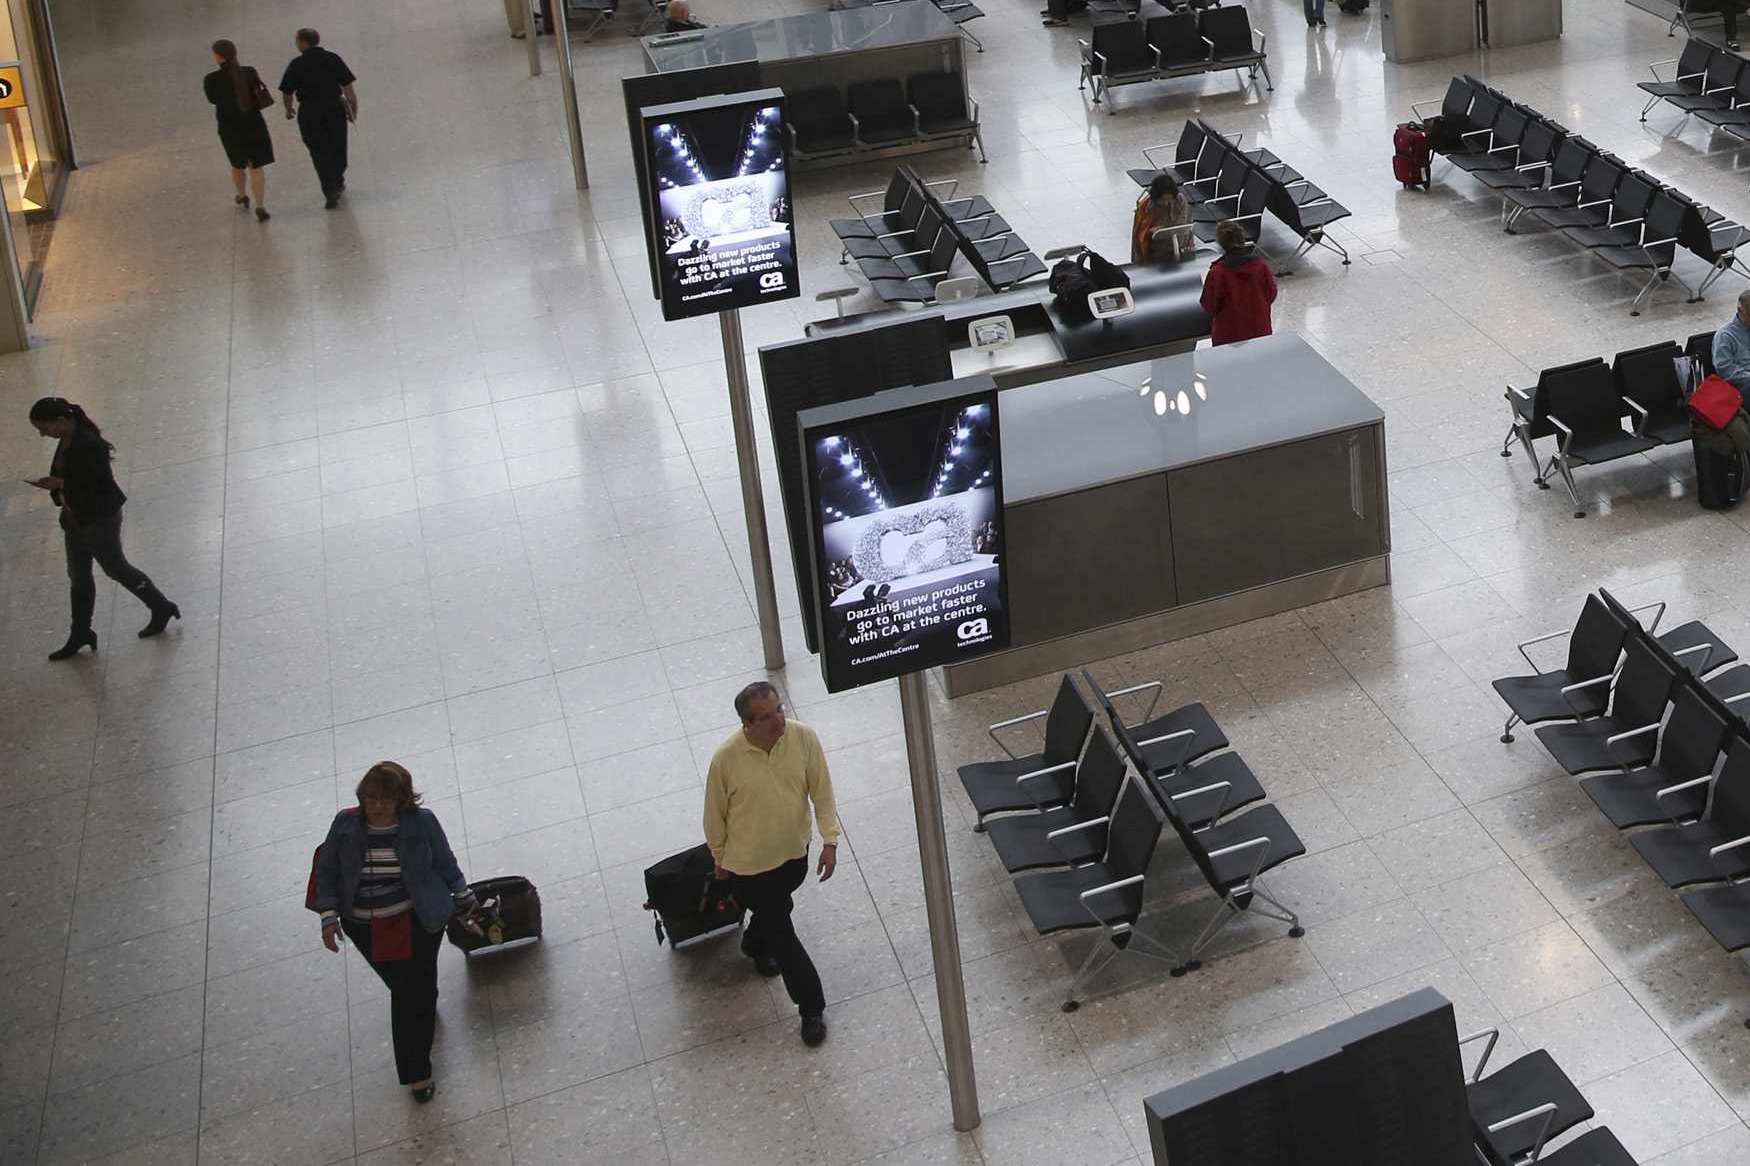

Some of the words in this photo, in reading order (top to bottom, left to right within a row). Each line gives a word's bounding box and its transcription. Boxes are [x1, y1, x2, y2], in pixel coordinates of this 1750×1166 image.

[678, 253, 717, 267] Dazzling
[719, 248, 738, 259] new
[740, 241, 780, 258] products
[685, 266, 698, 276] go
[699, 263, 711, 272] to
[712, 256, 746, 270] market
[747, 252, 775, 263] faster
[680, 274, 701, 285] with
[703, 271, 718, 281] CA
[719, 268, 730, 278] at
[731, 265, 748, 275] the
[749, 260, 782, 272] centre.
[846, 600, 900, 621] Dazzling
[903, 593, 929, 607] new
[932, 578, 986, 602] products
[849, 630, 878, 646] with
[881, 625, 900, 637] CA
[902, 620, 917, 632] at
[919, 613, 941, 627] the
[943, 603, 987, 621] centre.
[857, 620, 873, 633] go
[875, 615, 890, 627] to
[893, 603, 938, 622] market
[941, 593, 978, 610] faster
[957, 617, 989, 640] ca
[957, 634, 993, 648] technologies
[851, 643, 920, 666] CA.com/AtTheCentre
